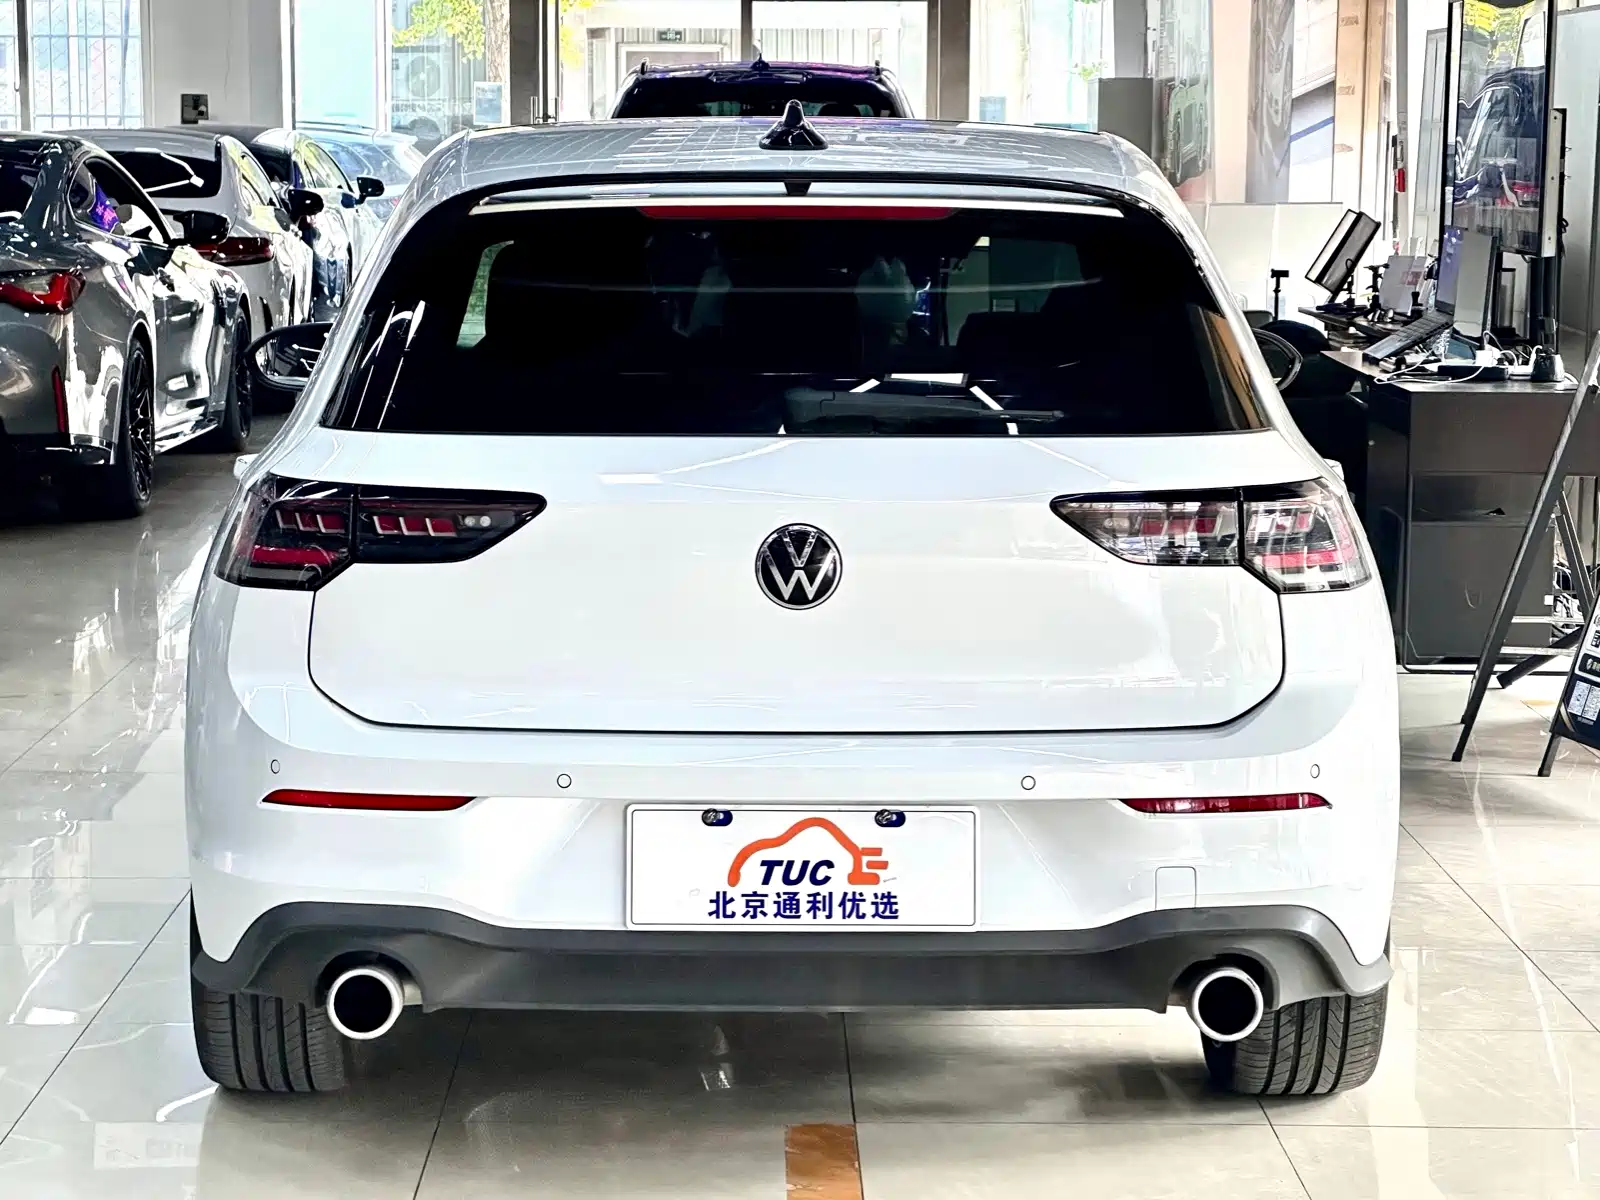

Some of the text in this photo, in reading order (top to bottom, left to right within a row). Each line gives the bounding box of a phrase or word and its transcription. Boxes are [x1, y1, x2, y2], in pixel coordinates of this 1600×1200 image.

[759, 859, 835, 886] TUC
[707, 891, 899, 920] 北京通利优选
